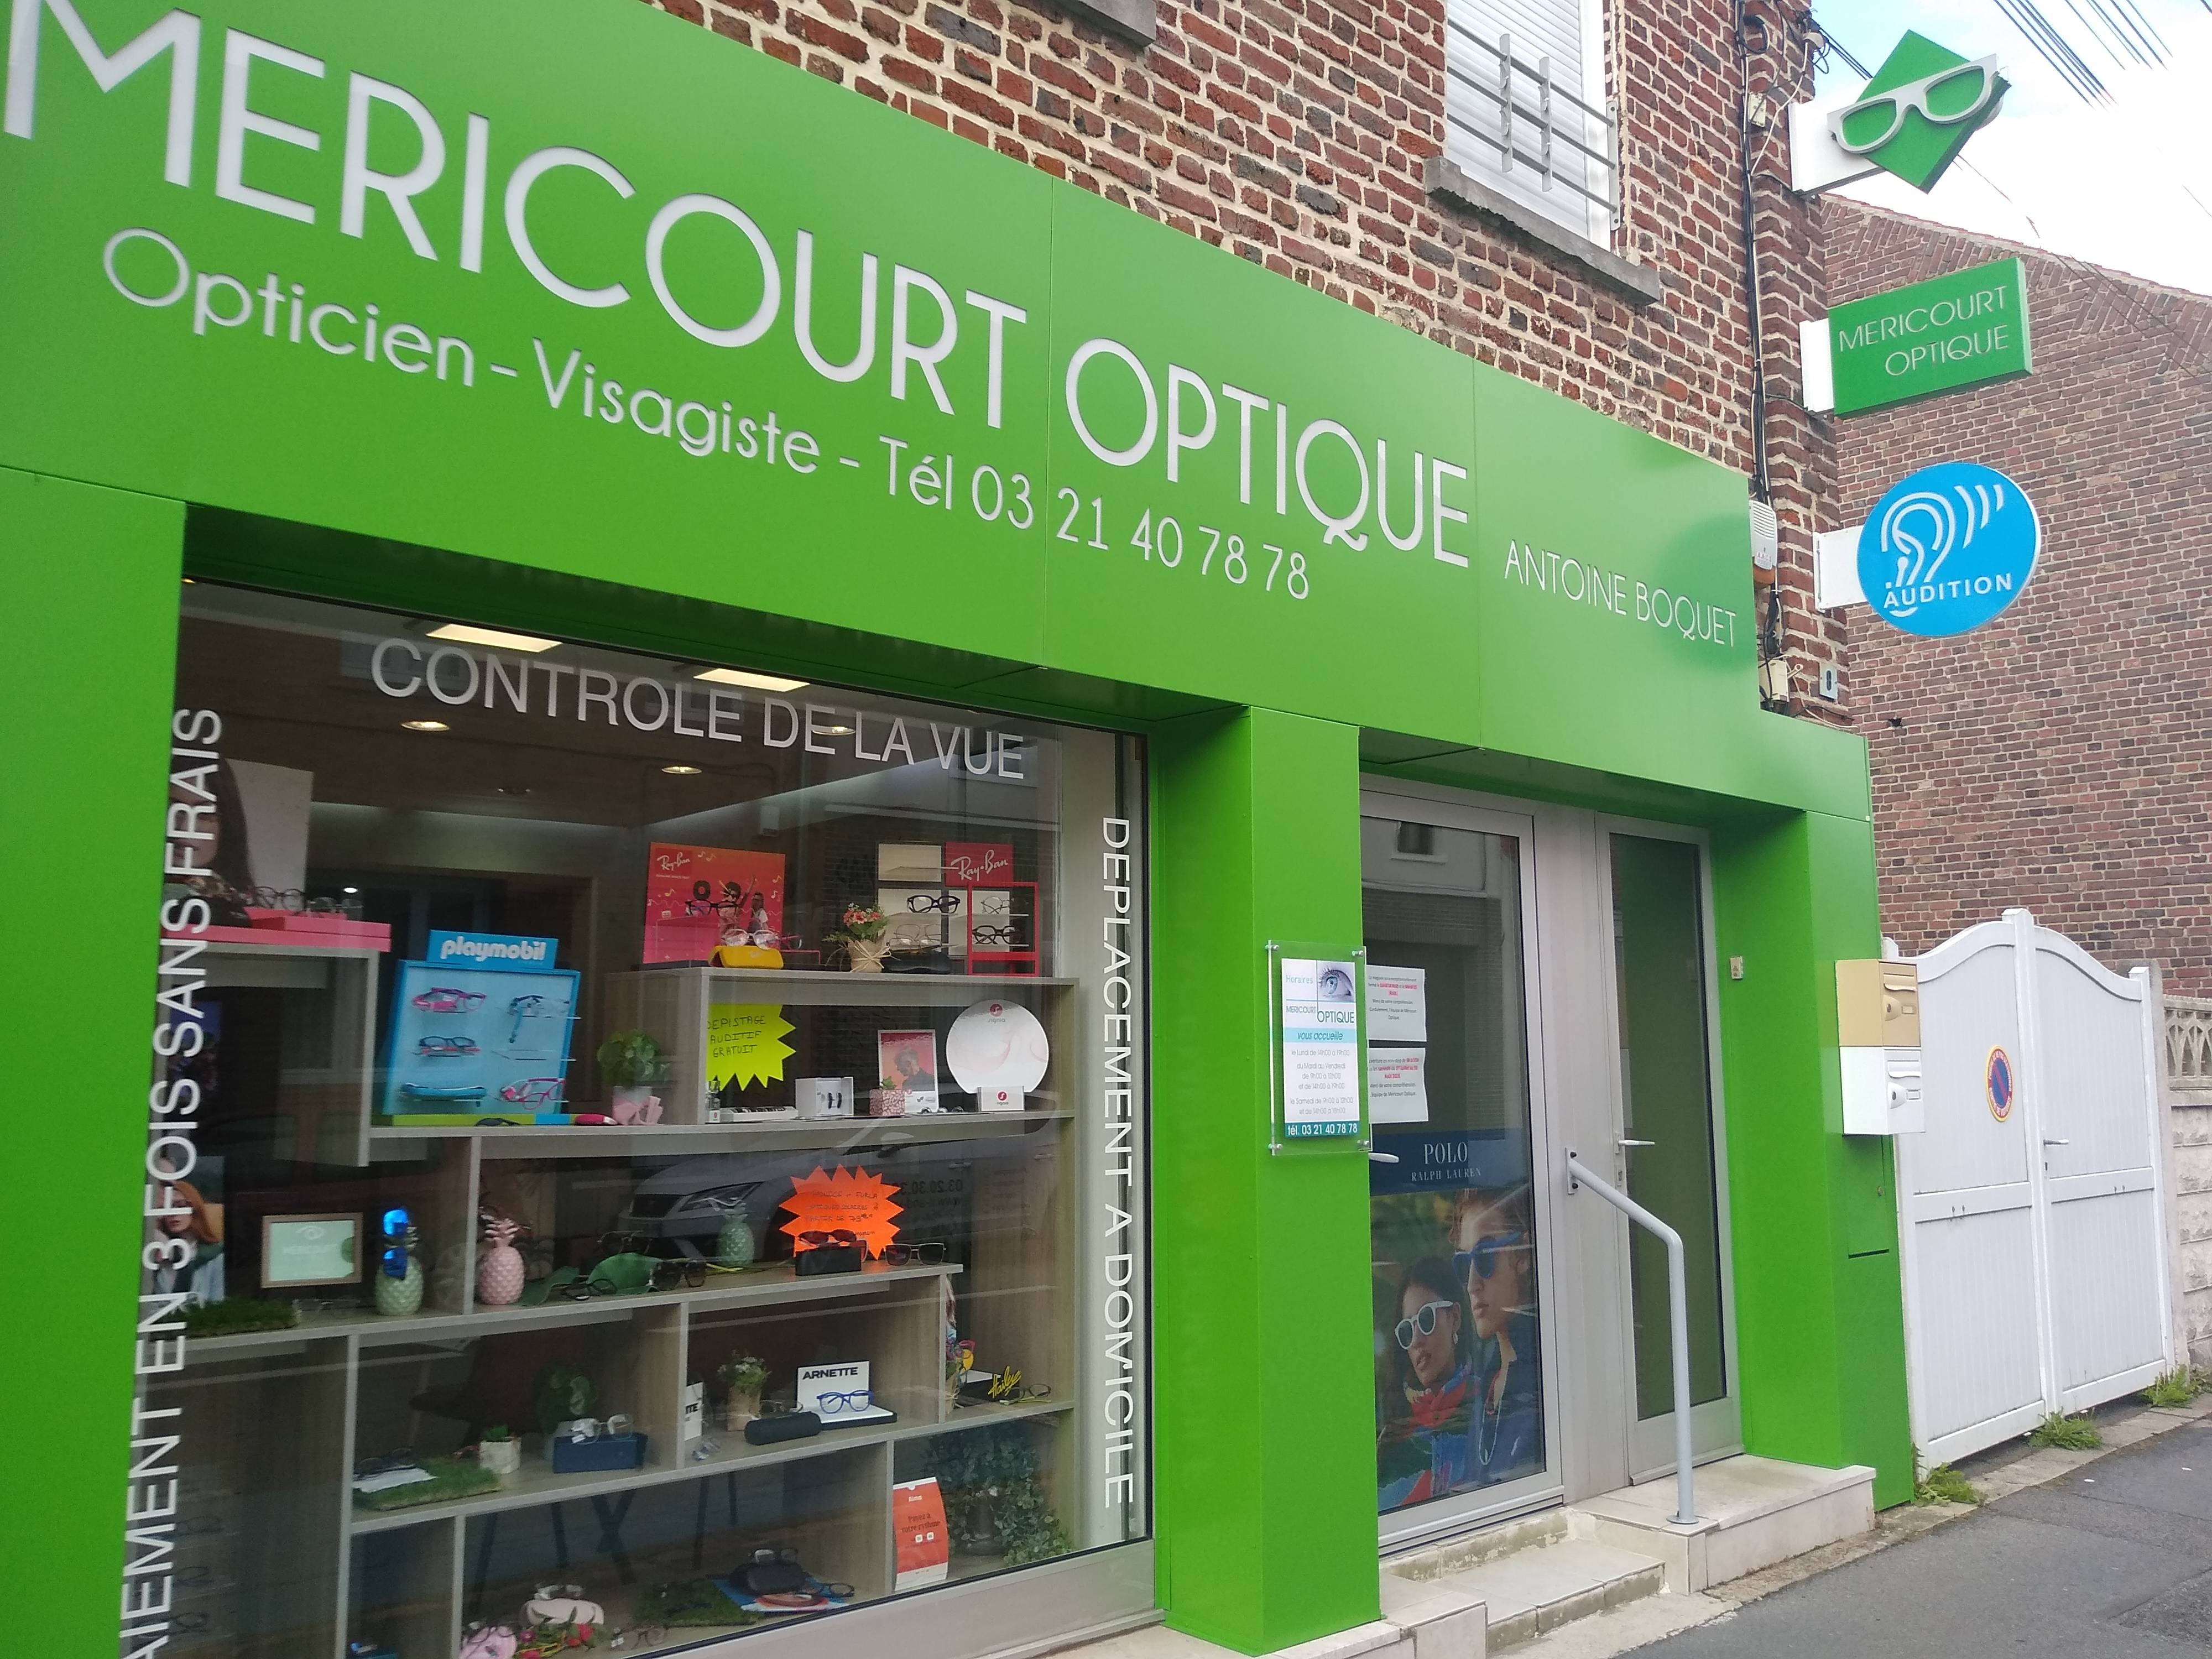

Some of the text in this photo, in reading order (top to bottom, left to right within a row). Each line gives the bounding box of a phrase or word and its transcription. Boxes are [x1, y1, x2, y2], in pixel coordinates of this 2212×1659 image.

[3, 0, 1468, 568] MERICOURT OPTIQUE
[1839, 285, 2007, 352] MERICOURT
[1885, 325, 2008, 375] OPTIQUE
[104, 227, 472, 387] Opticien
[532, 337, 820, 473] Visagiste
[879, 434, 952, 510] Tél
[972, 464, 1034, 530] 03
[1056, 487, 1109, 550] 21
[1131, 505, 1183, 568] 40
[1198, 526, 1248, 585] 78
[1263, 544, 1309, 599] 78
[1504, 539, 1736, 647] ANTOINE BOQUET
[1884, 573, 2011, 608] AUDITION
[371, 638, 1025, 779] CONTROLE DE LA VUE
[164, 708, 222, 877] FRAIS
[440, 936, 546, 962] playmobil
[153, 898, 211, 1057] SANS
[1286, 975, 1313, 984] Horaires
[1286, 1005, 1354, 1024] MERICOURT OPTIQUE
[711, 1030, 761, 1044] AUDITIF
[713, 1045, 758, 1057] GRATUIT
[1298, 1031, 1343, 1040] vous accueille
[1287, 1123, 1358, 1135] tél. 03 21 40 78 78
[144, 1079, 201, 1218] FOIS
[1103, 817, 1134, 1507] DEPLACEMENT A DOMICILE
[1424, 1141, 1468, 1165] POLO
[1411, 1167, 1481, 1181] RALPH LAUREN
[142, 1238, 193, 1271] 3
[135, 1293, 188, 1374] EN
[802, 1366, 858, 1381] ARNETTE
